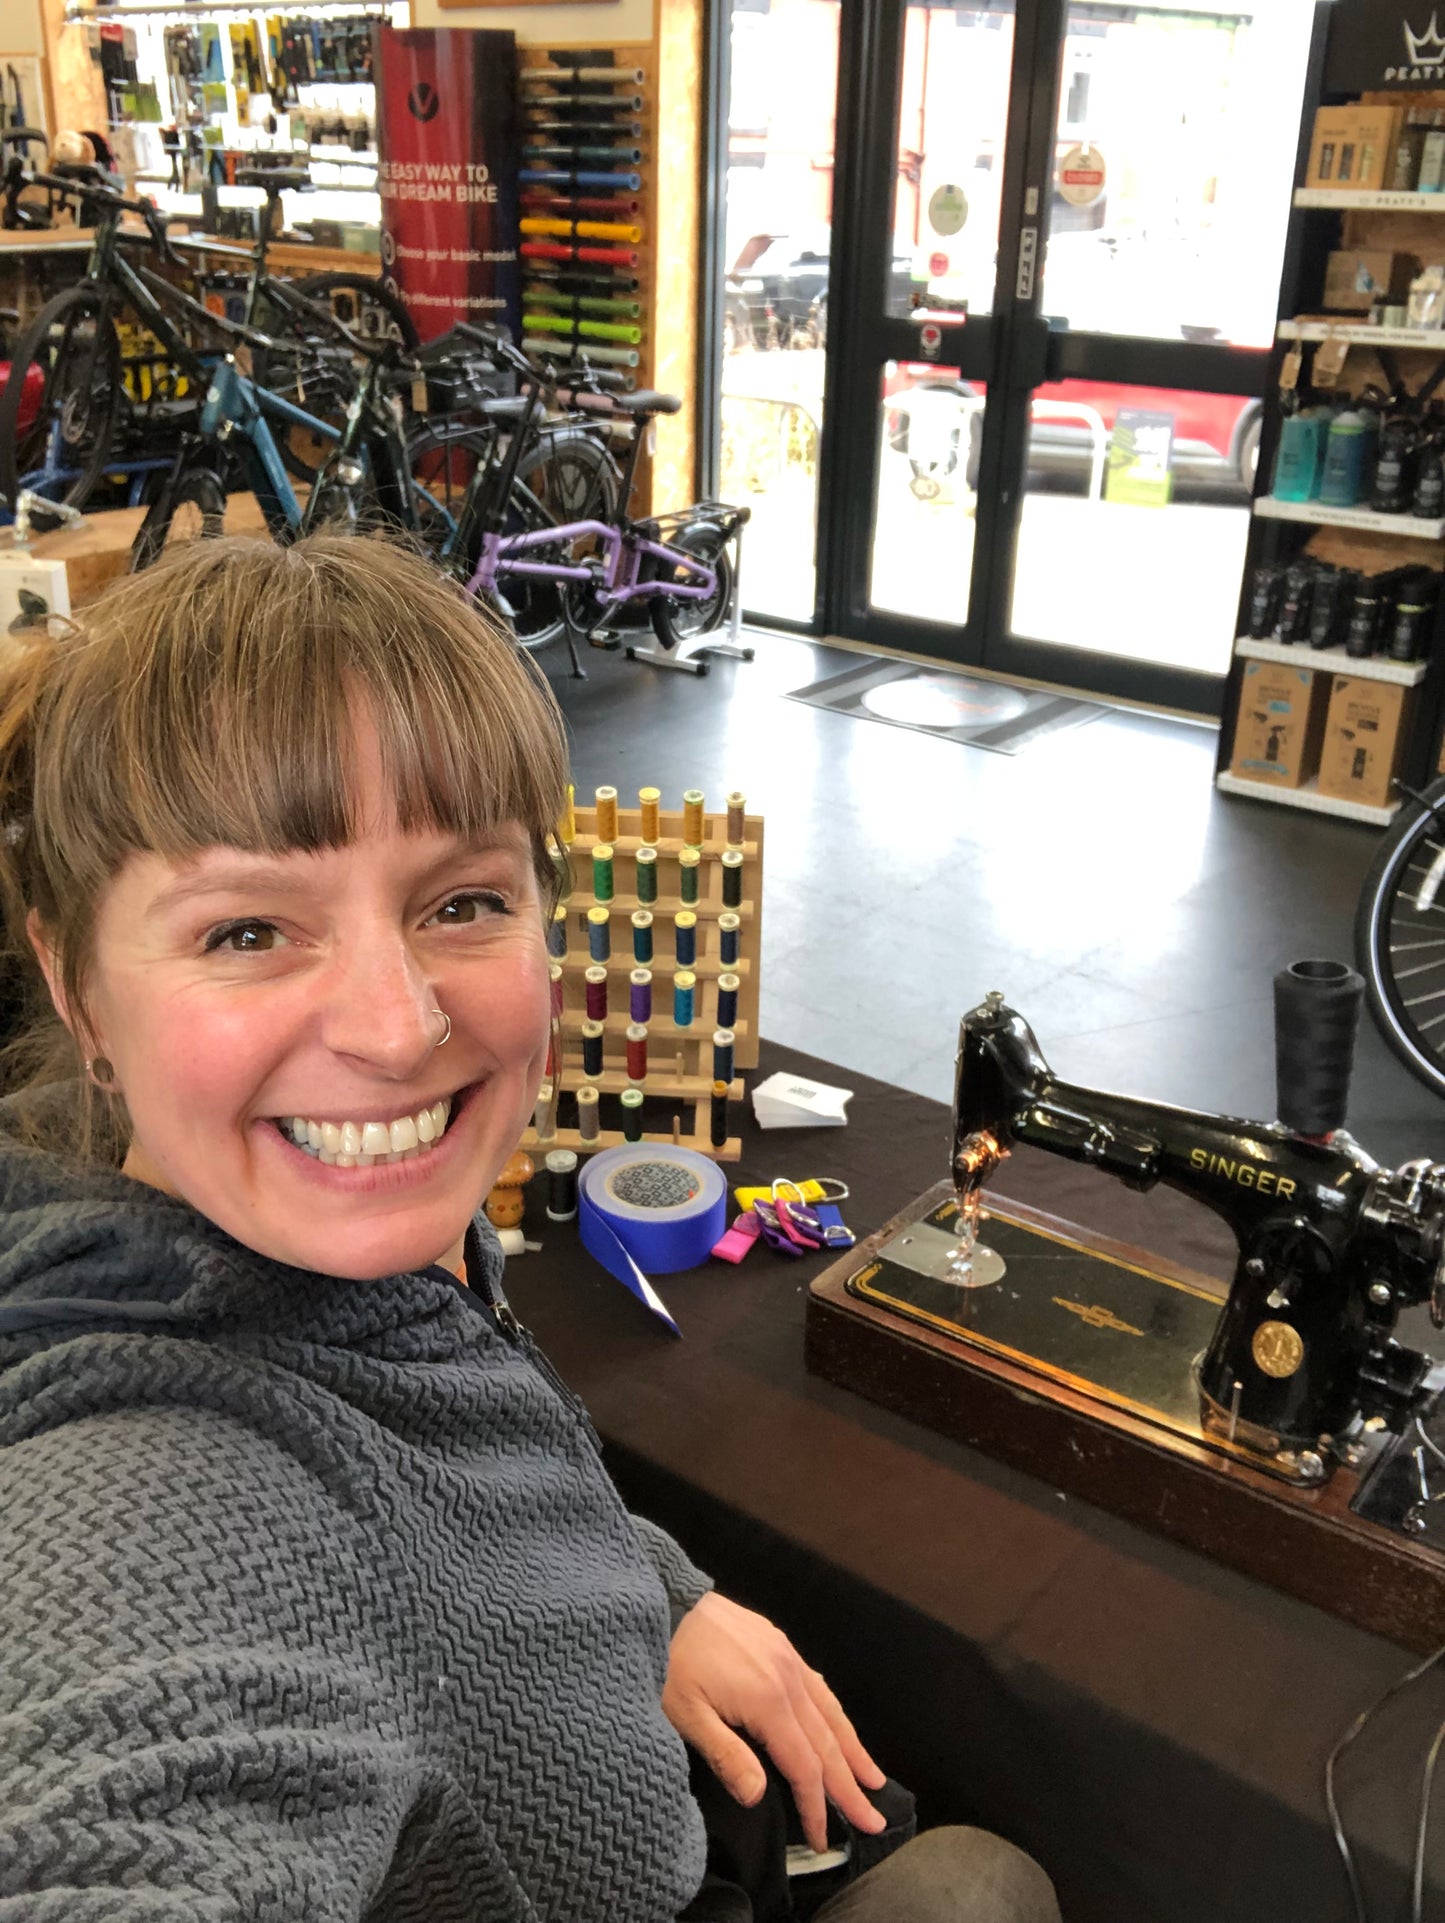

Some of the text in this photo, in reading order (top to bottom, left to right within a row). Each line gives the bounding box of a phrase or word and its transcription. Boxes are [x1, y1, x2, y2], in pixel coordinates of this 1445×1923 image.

[391, 162, 424, 180] EASY
[425, 163, 462, 182] WAY
[465, 164, 489, 183] TO
[399, 183, 452, 201] DREAM
[456, 185, 499, 203] BIKE
[1189, 1147, 1298, 1201] SINGER
